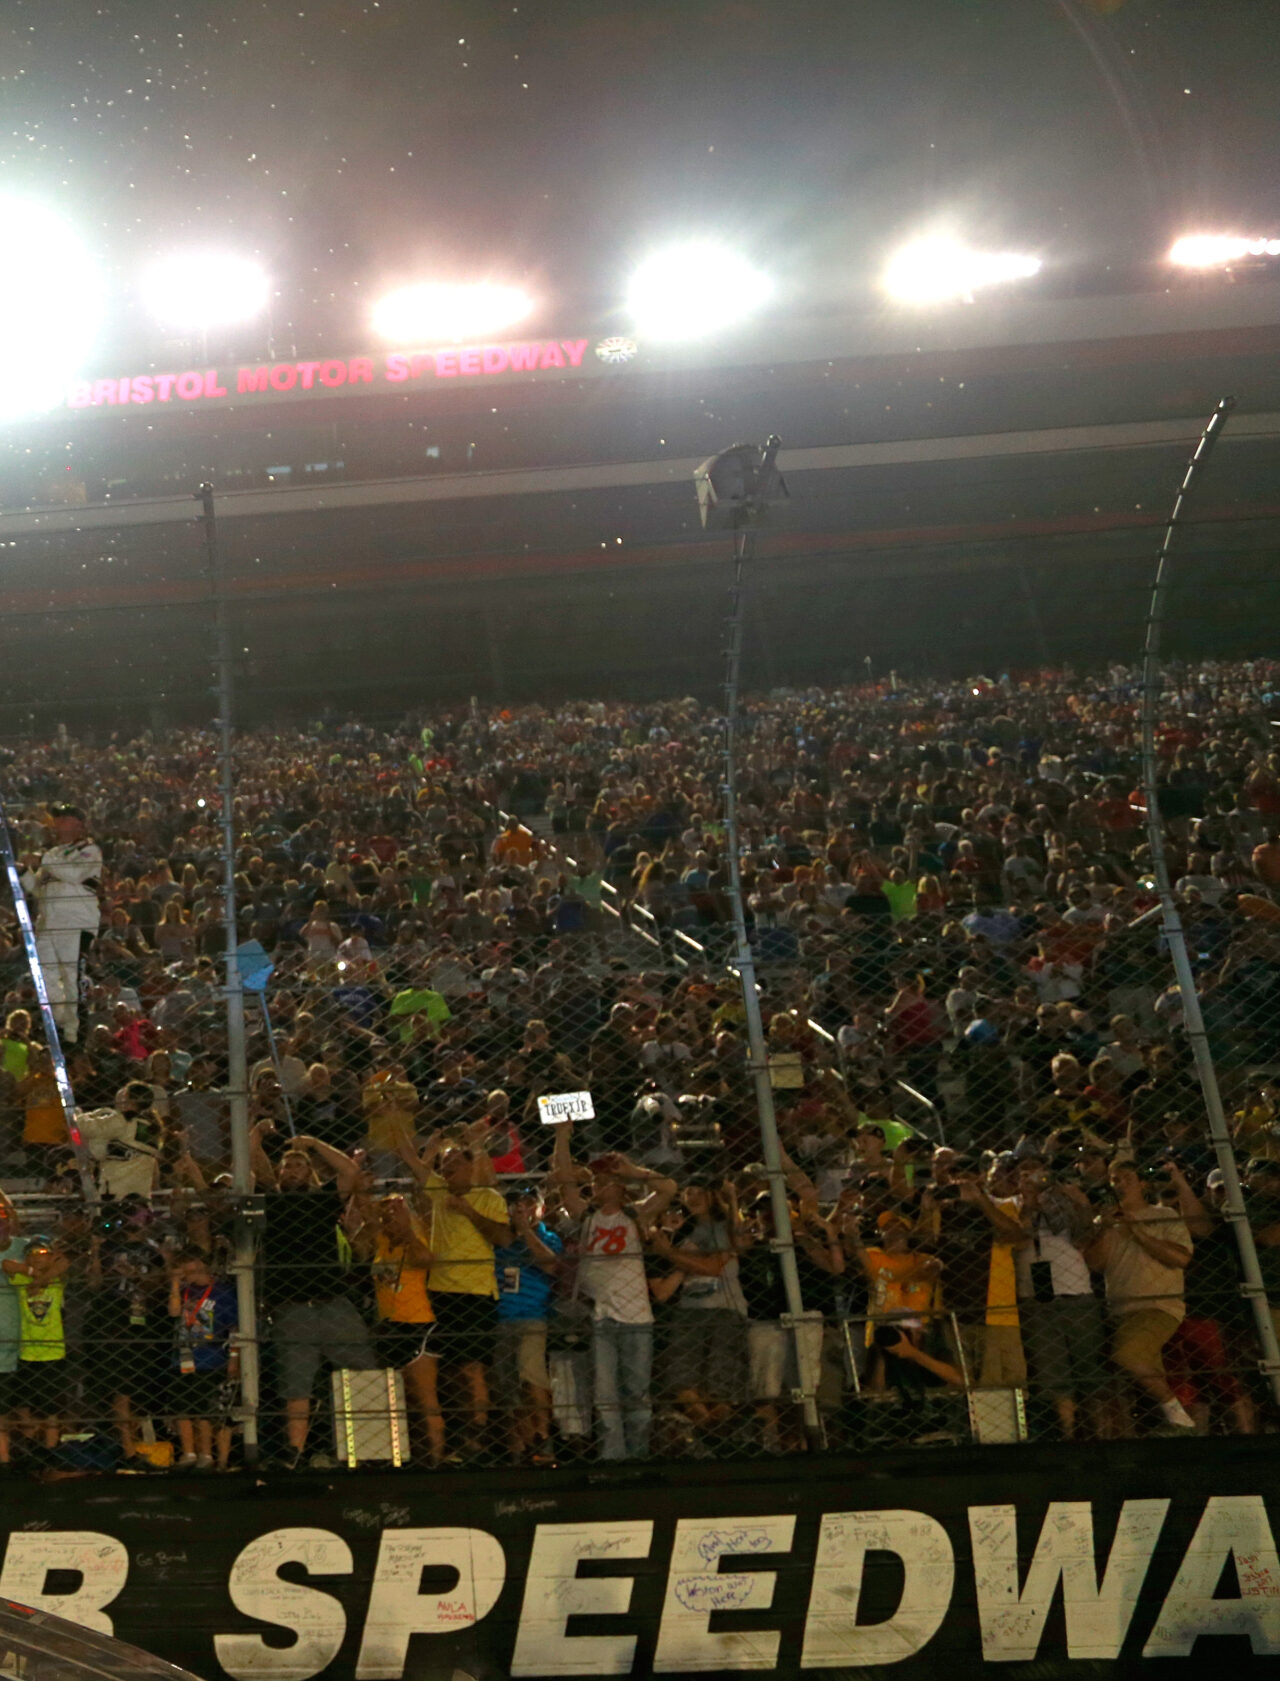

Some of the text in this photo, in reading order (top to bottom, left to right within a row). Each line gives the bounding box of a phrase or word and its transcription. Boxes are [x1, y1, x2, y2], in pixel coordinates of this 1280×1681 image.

[68, 339, 589, 409] BRISTOL MOTOR SPEEDWAY
[587, 1225, 627, 1254] 78
[213, 1495, 1280, 1681] SPEEDWA
